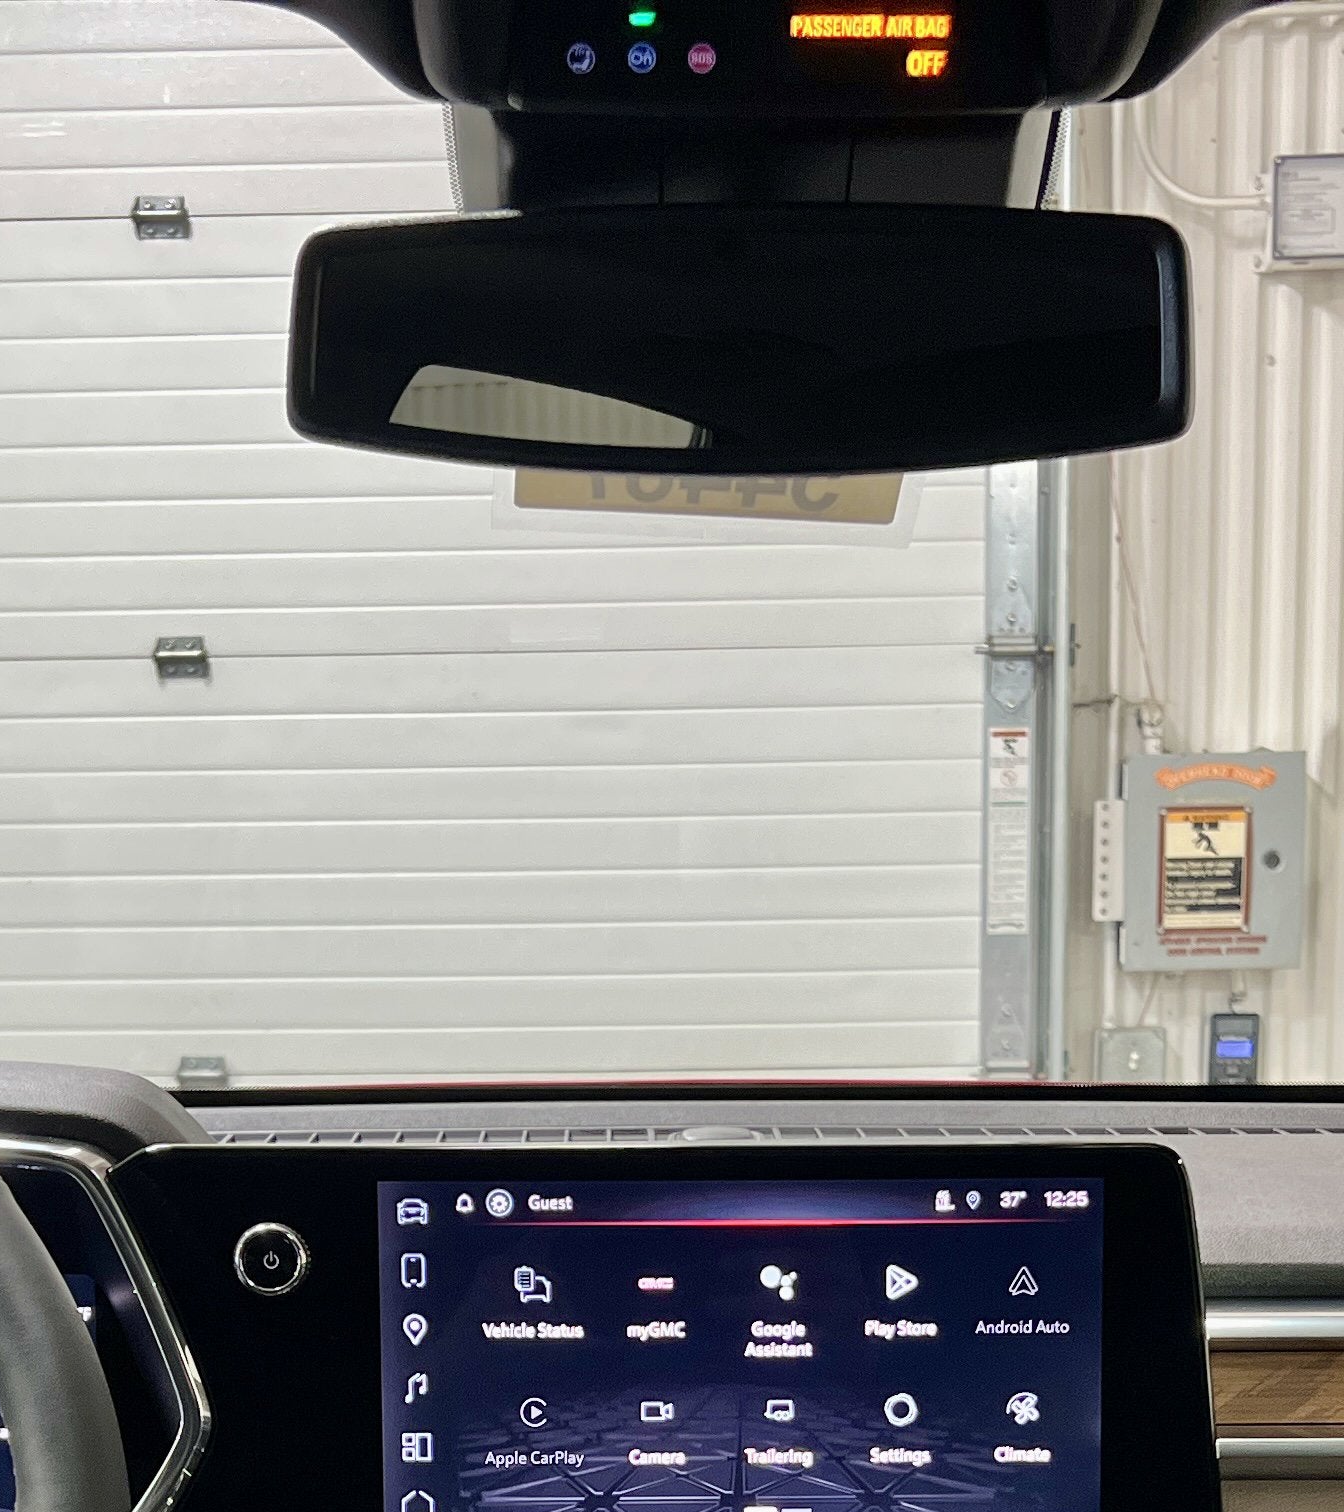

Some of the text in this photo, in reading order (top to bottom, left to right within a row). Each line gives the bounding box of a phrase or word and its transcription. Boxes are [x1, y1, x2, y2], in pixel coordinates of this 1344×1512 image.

[790, 14, 950, 38] PASSENGER AIR BAG
[906, 50, 948, 77] OFF
[527, 1194, 574, 1211] Guest
[999, 1190, 1027, 1208] 37°
[1044, 1190, 1090, 1208] 12:25
[482, 1322, 584, 1338] Vehicle Status
[626, 1321, 686, 1341] myGMC
[750, 1320, 806, 1340] Google
[864, 1320, 937, 1340] Play Store
[975, 1320, 1070, 1334] Android Auto
[744, 1342, 813, 1358] Assistant
[484, 1450, 584, 1469] Apple CarPlay
[628, 1448, 686, 1465] Camera
[744, 1447, 814, 1469] Trailering
[869, 1447, 931, 1467] Settings
[993, 1446, 1052, 1463] Climate
